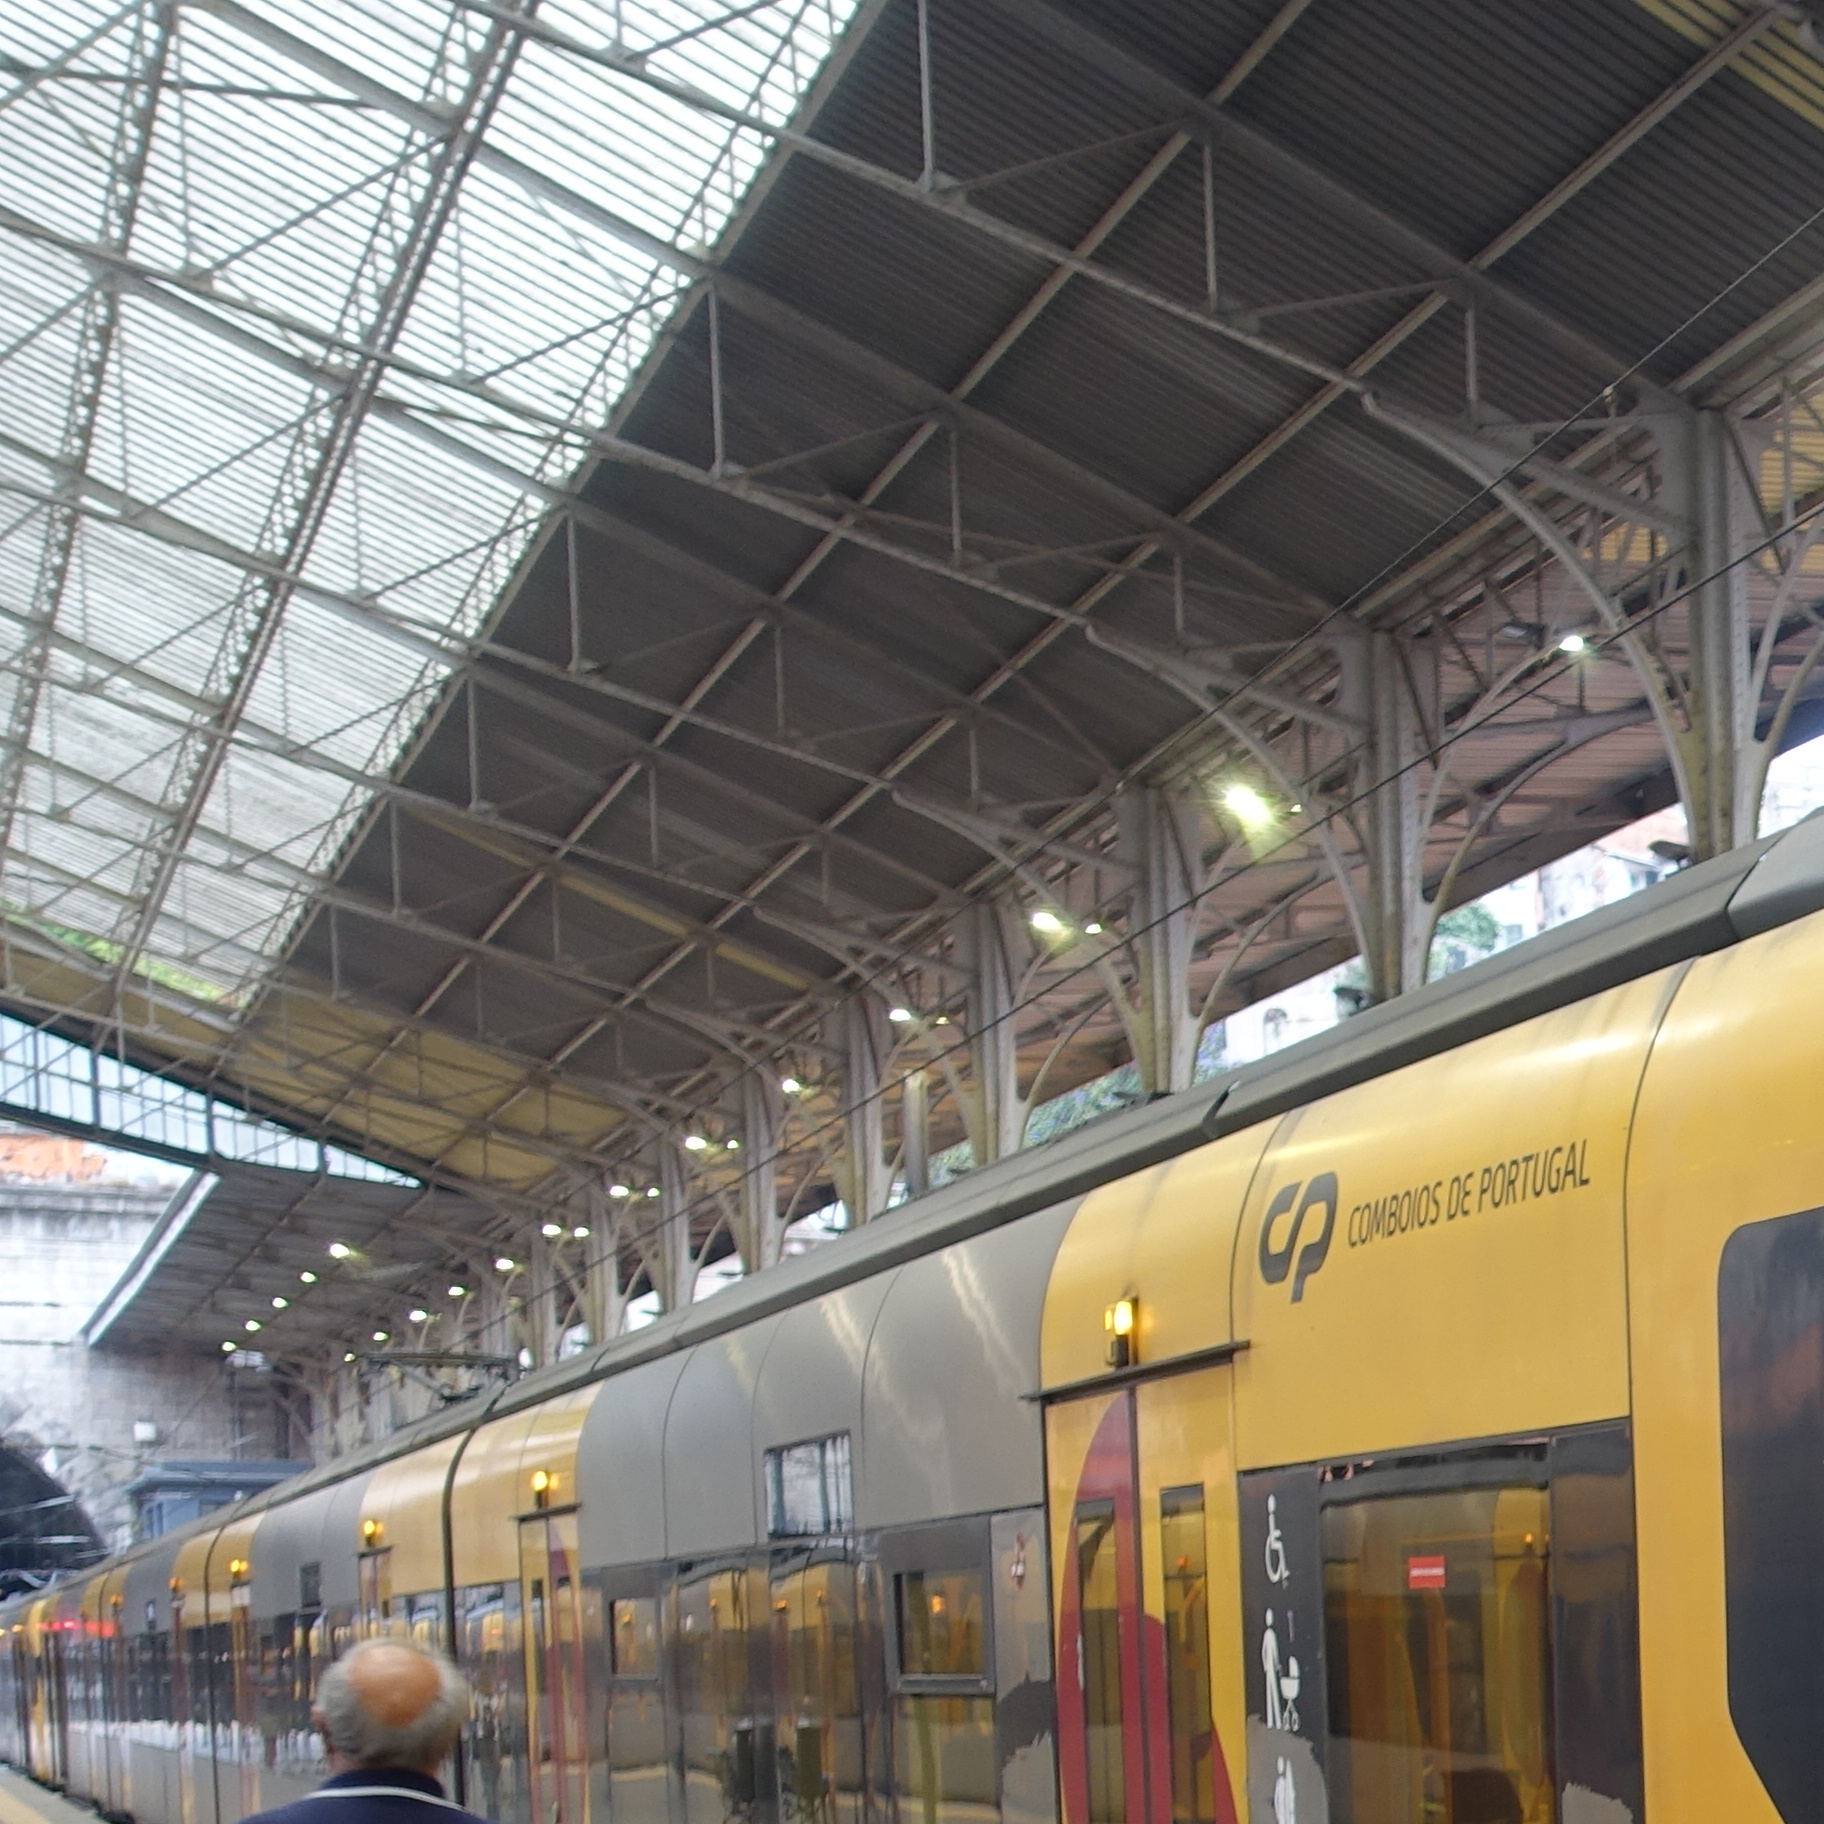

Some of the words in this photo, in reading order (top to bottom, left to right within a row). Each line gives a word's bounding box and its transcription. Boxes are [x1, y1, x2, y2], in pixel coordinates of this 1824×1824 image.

[1348, 1180, 1442, 1248] COMBOIOS
[1446, 1171, 1474, 1221] DE
[1477, 1139, 1590, 1212] PORTUGAL
